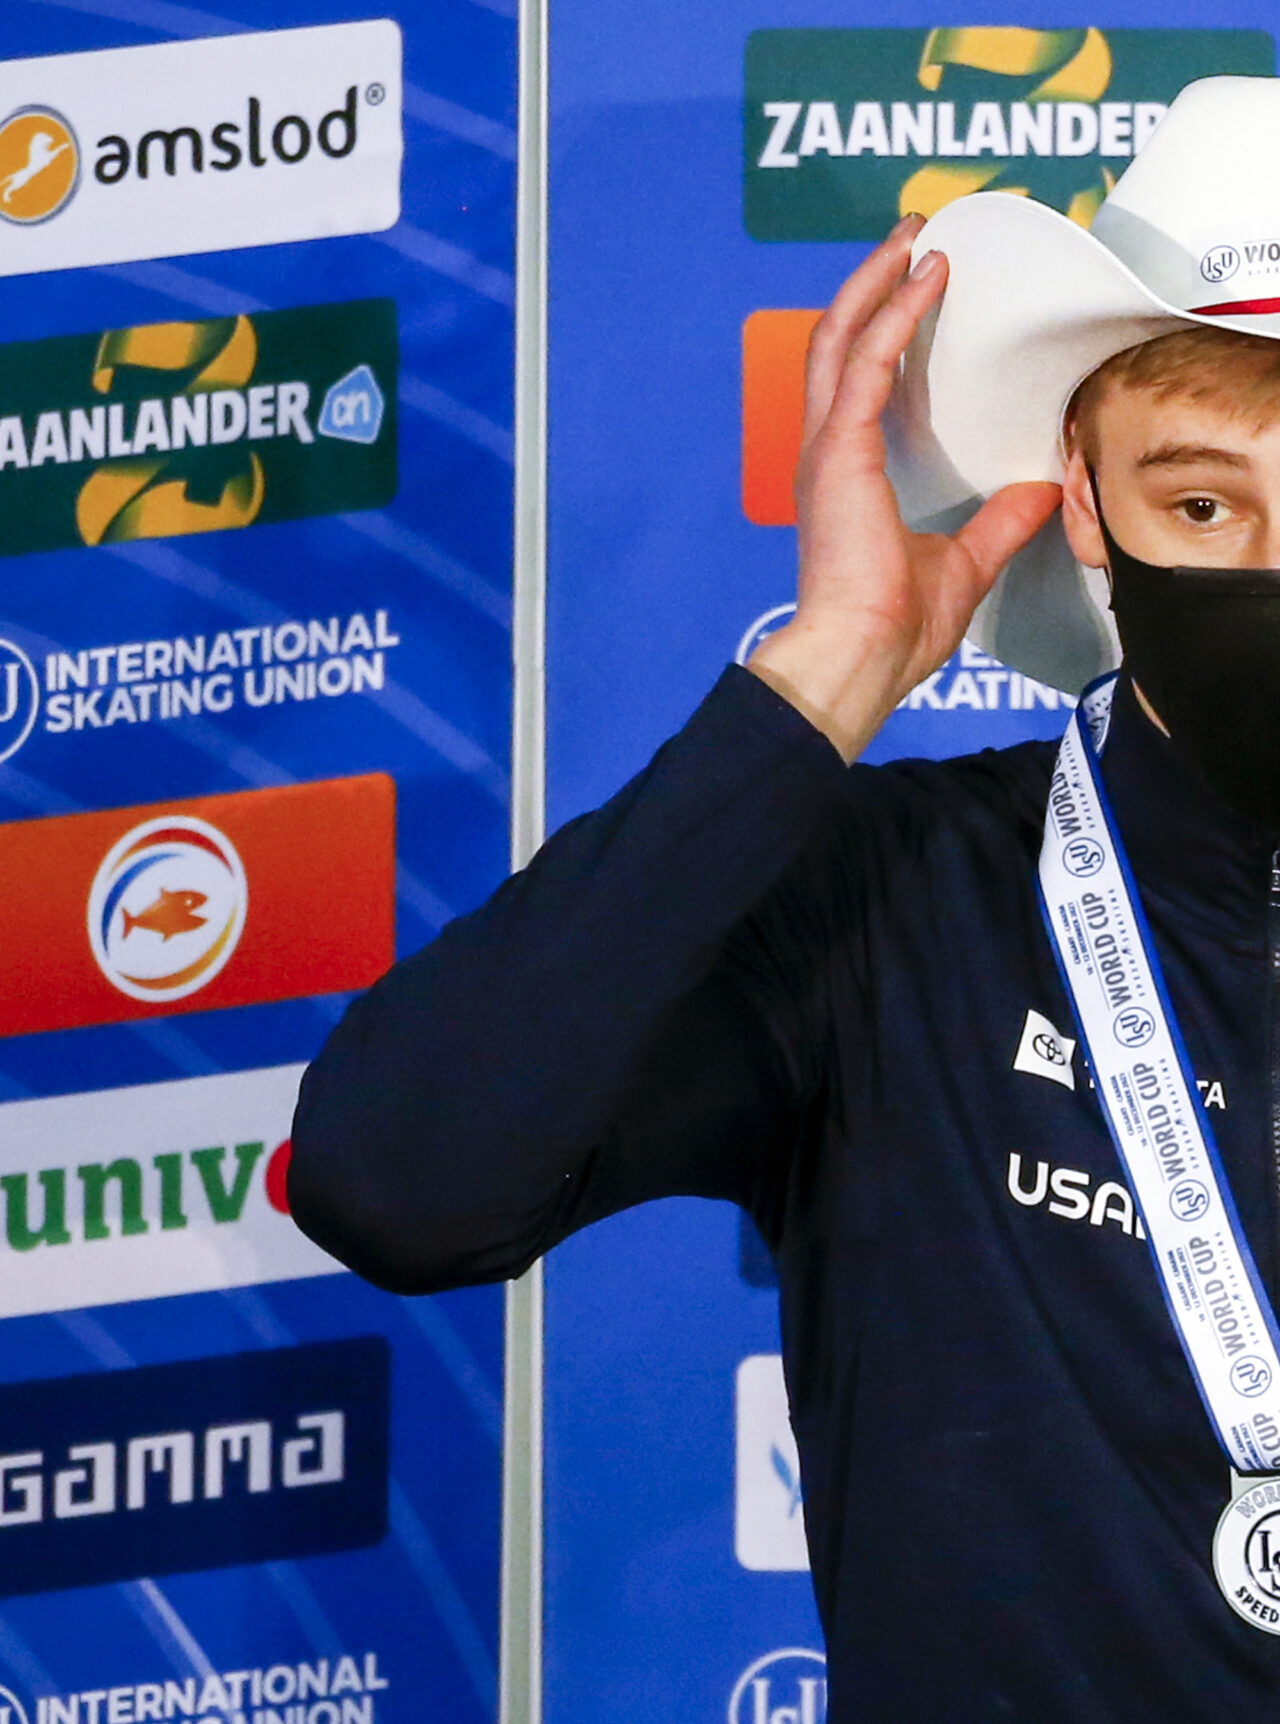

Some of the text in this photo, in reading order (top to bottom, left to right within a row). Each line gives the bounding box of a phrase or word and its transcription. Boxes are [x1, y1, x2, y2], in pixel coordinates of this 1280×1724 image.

[46, 610, 400, 692] INTERNATIONAL
[45, 675, 233, 733] SKATING
[243, 652, 385, 707] UNION
[1081, 892, 1133, 1008] WORLD CUP
[1119, 1013, 1151, 1044] ISU
[1132, 1063, 1187, 1182] WORLD CUP
[1175, 1186, 1207, 1217] ISU
[1189, 1236, 1247, 1357] WORLD CUP
[1236, 1362, 1269, 1393] ISU
[1233, 1585, 1279, 1624] SPEED
[37, 1652, 389, 1724] INTERNATIONAL
